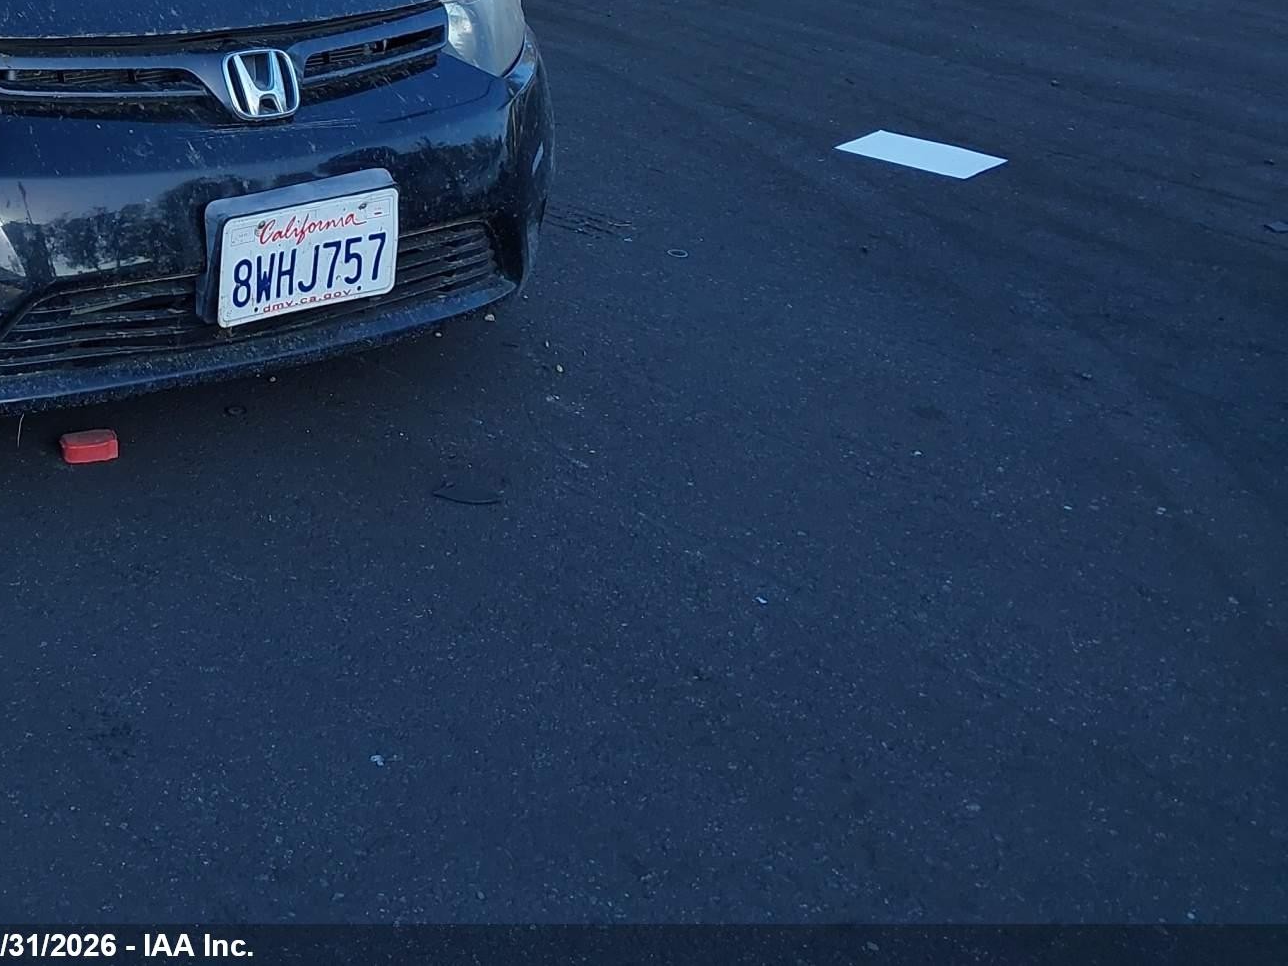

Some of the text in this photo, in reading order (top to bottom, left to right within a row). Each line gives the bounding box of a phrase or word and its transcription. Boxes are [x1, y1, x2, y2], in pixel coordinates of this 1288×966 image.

[258, 211, 367, 245] California
[232, 232, 386, 308] 8WHJ757
[263, 289, 352, 314] dmv.ca.gov
